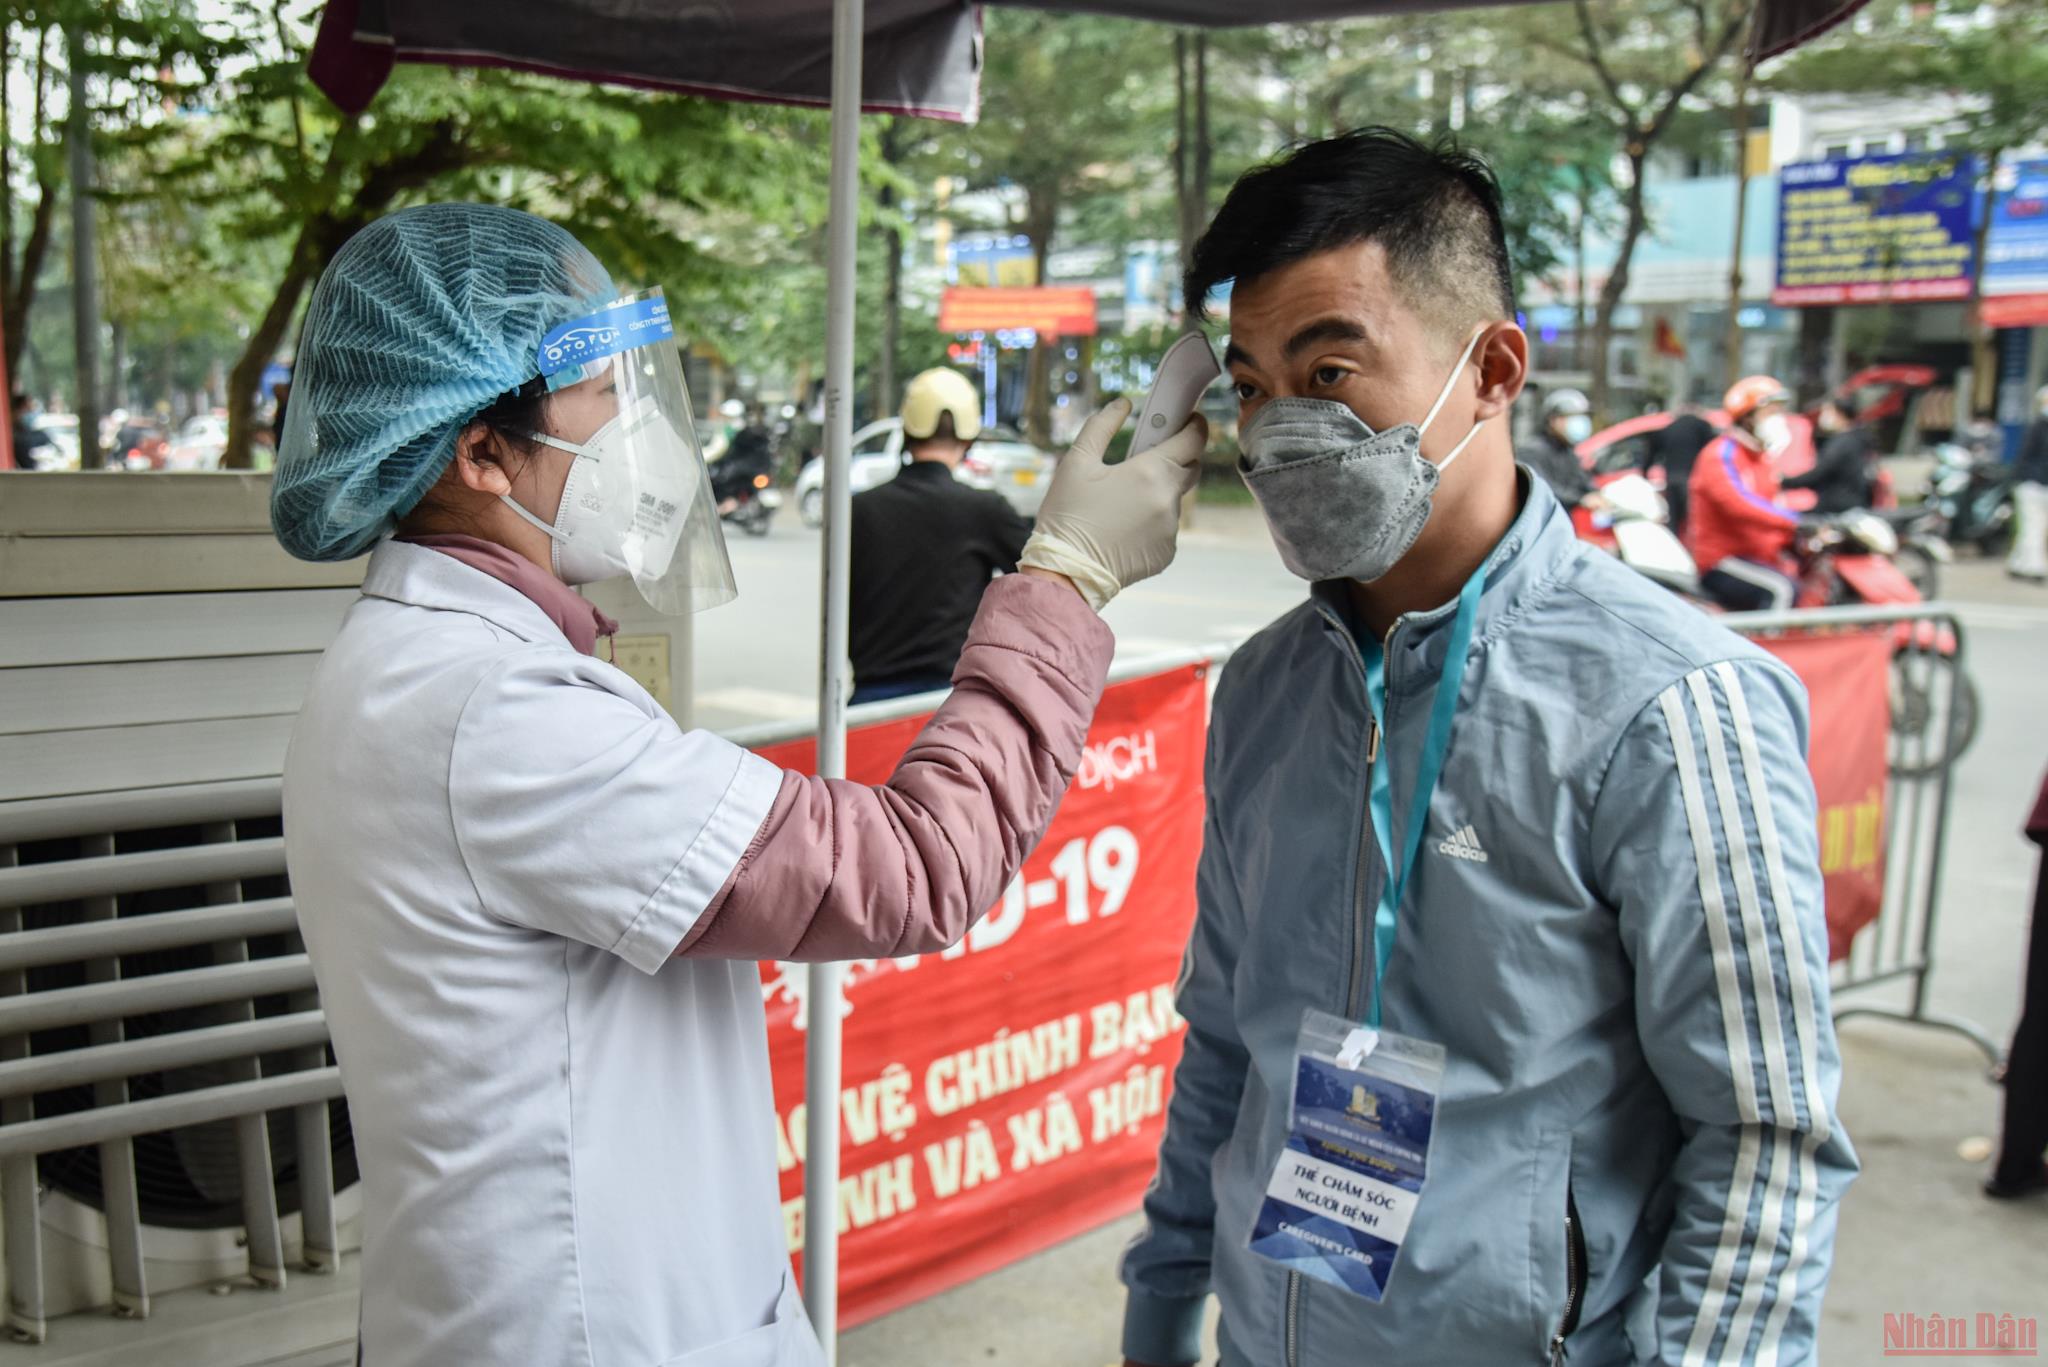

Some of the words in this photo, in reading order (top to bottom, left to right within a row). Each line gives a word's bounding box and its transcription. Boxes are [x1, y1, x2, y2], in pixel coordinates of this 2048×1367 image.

[547, 329, 621, 361] OTOFUN
[1439, 842, 1488, 863] adidas
[841, 1063, 917, 1147] VỆ
[925, 1027, 1081, 1117] CHÍNH
[1089, 983, 1185, 1059] BẠN
[924, 1119, 1000, 1200] VÀ
[1007, 1091, 1083, 1173] XÃ
[1088, 1063, 1166, 1143] HỘI
[1341, 1205, 1379, 1228] BỆNH
[1366, 1190, 1396, 1211] SÓC
[1278, 1221, 1344, 1254] CAREGIVER'S
[1343, 1247, 1374, 1265] CARD
